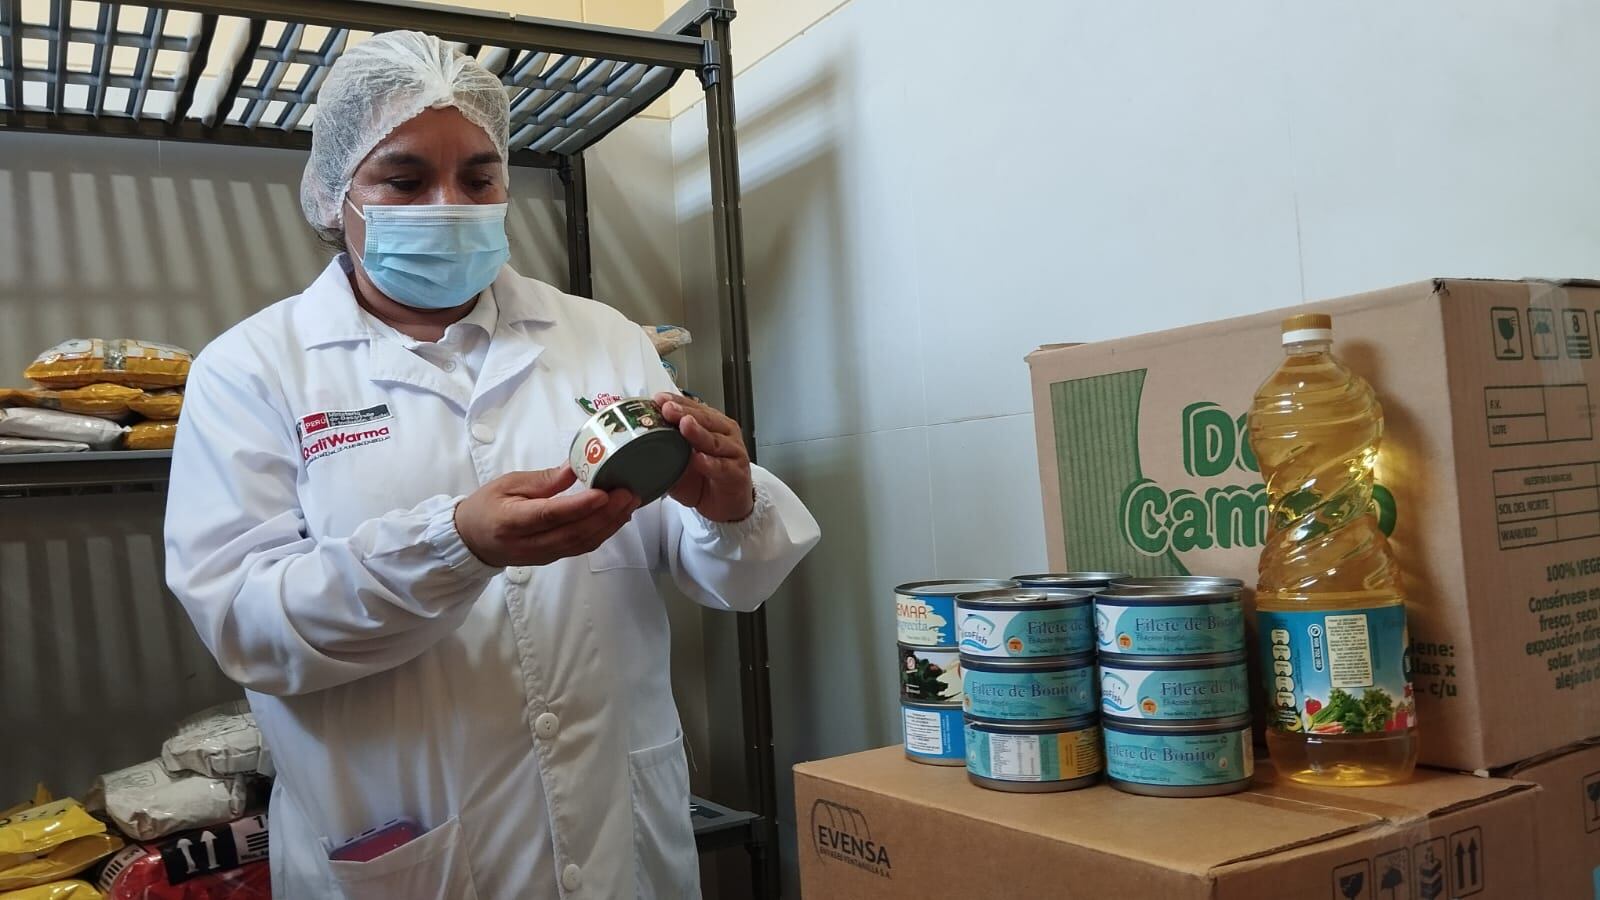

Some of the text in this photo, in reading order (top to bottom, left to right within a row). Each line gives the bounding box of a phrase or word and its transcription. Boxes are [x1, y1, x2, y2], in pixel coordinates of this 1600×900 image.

[304, 418, 326, 430] PERÚ
[1498, 503, 1512, 515] SOL
[1513, 502, 1526, 513] DEL
[1546, 563, 1575, 582] 100%
[1528, 589, 1588, 613] Consérvese
[1028, 621, 1068, 635] Filete
[1135, 616, 1179, 632] Filete
[1184, 616, 1201, 631] de
[1539, 608, 1598, 632] fresco, seco
[1526, 627, 1581, 656] exposición
[1547, 650, 1576, 671] solar.
[1445, 664, 1456, 677] x
[1555, 666, 1592, 690] alejado
[971, 680, 1078, 698] Filete de Bonito
[1161, 681, 1206, 697] Filete
[1430, 680, 1457, 698] c/u
[1139, 746, 1157, 761] de
[1162, 746, 1216, 762] Bonito
[818, 825, 892, 869] EVENSA
